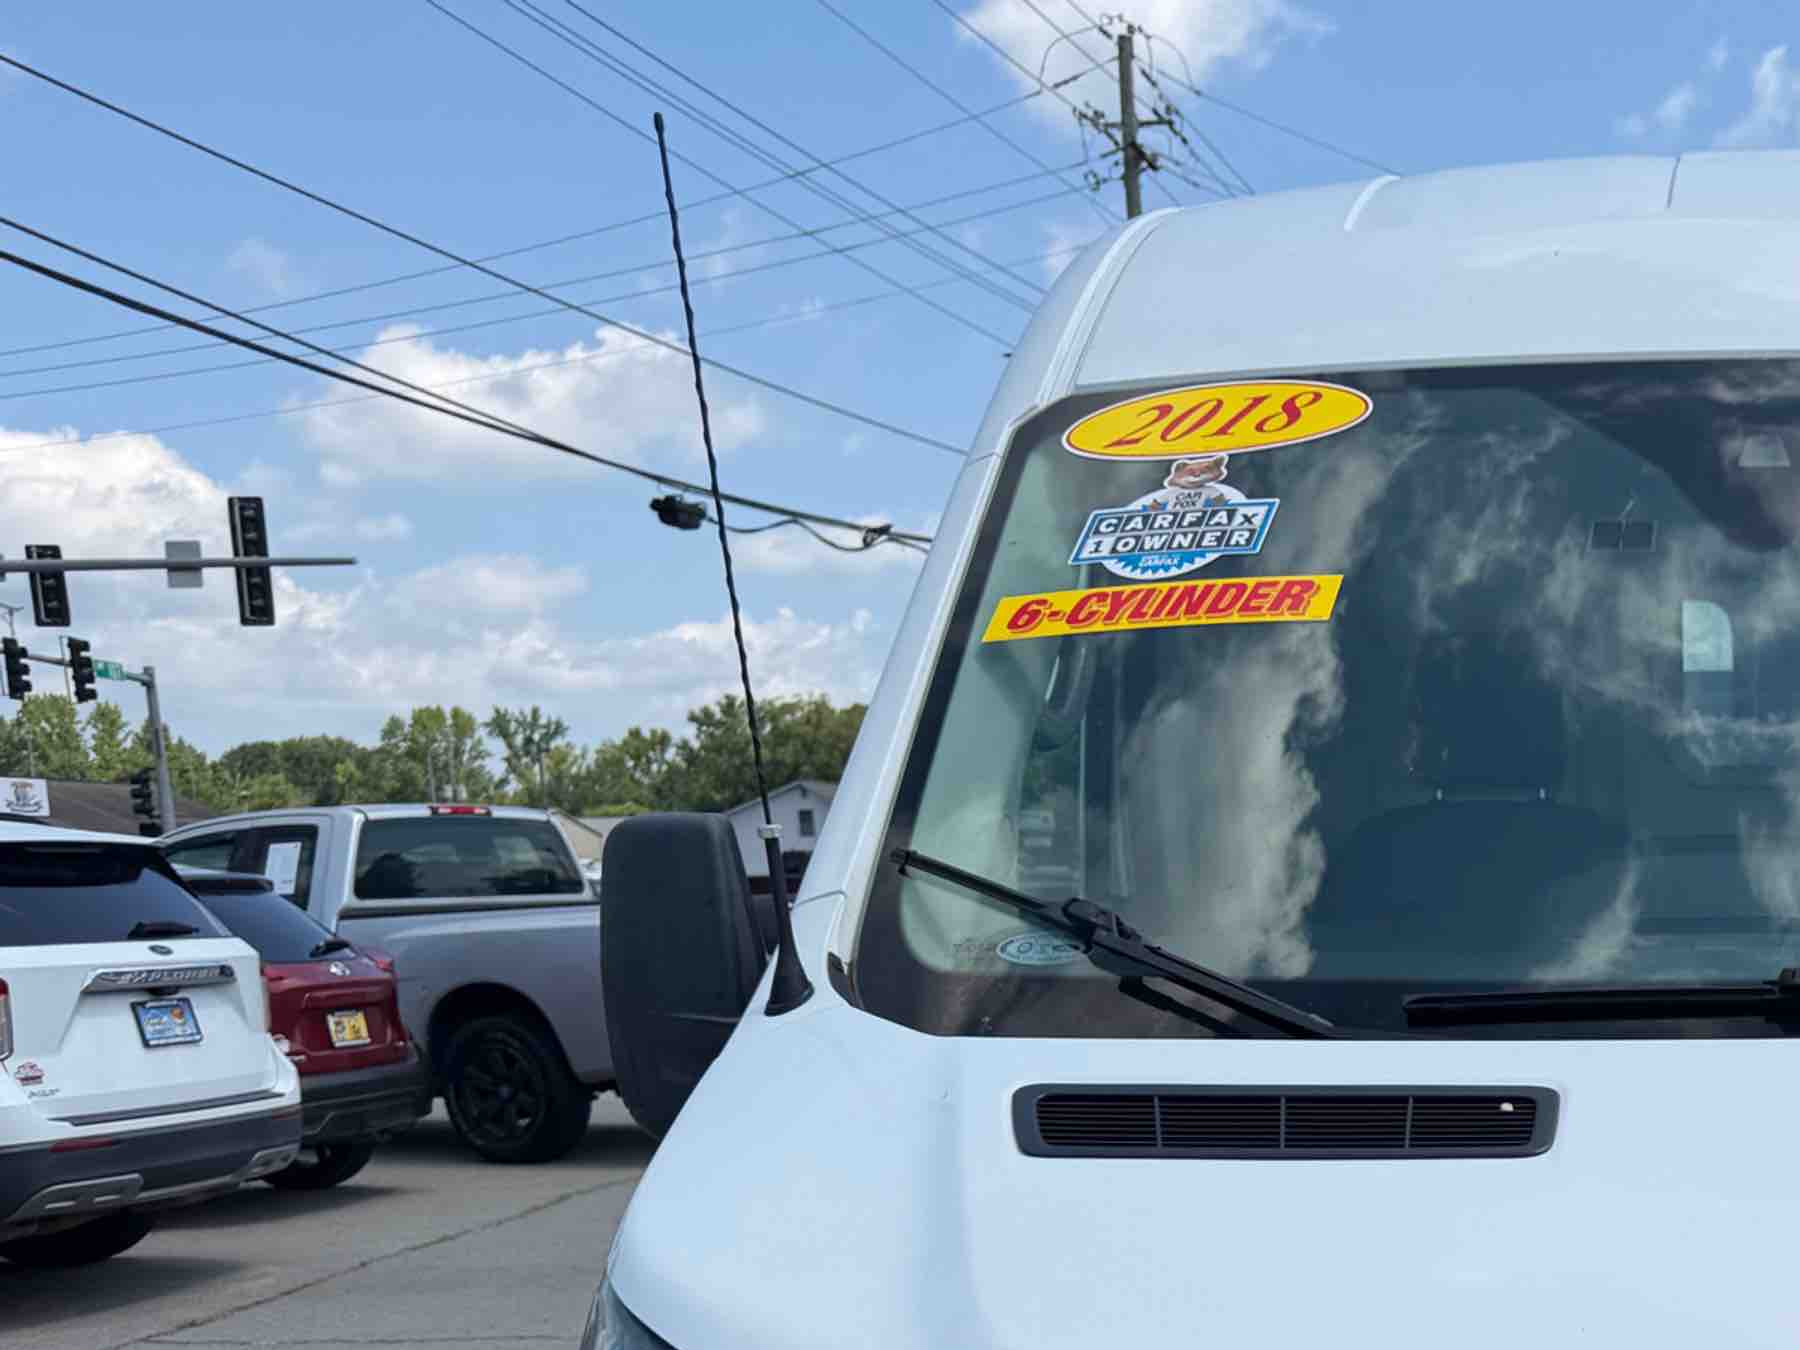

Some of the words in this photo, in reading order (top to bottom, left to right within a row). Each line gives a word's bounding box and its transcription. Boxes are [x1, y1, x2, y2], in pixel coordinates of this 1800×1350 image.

[1104, 391, 1323, 449] 2018
[1098, 509, 1259, 533] CARFAX
[1007, 579, 1321, 633] 6-CYLINDER
